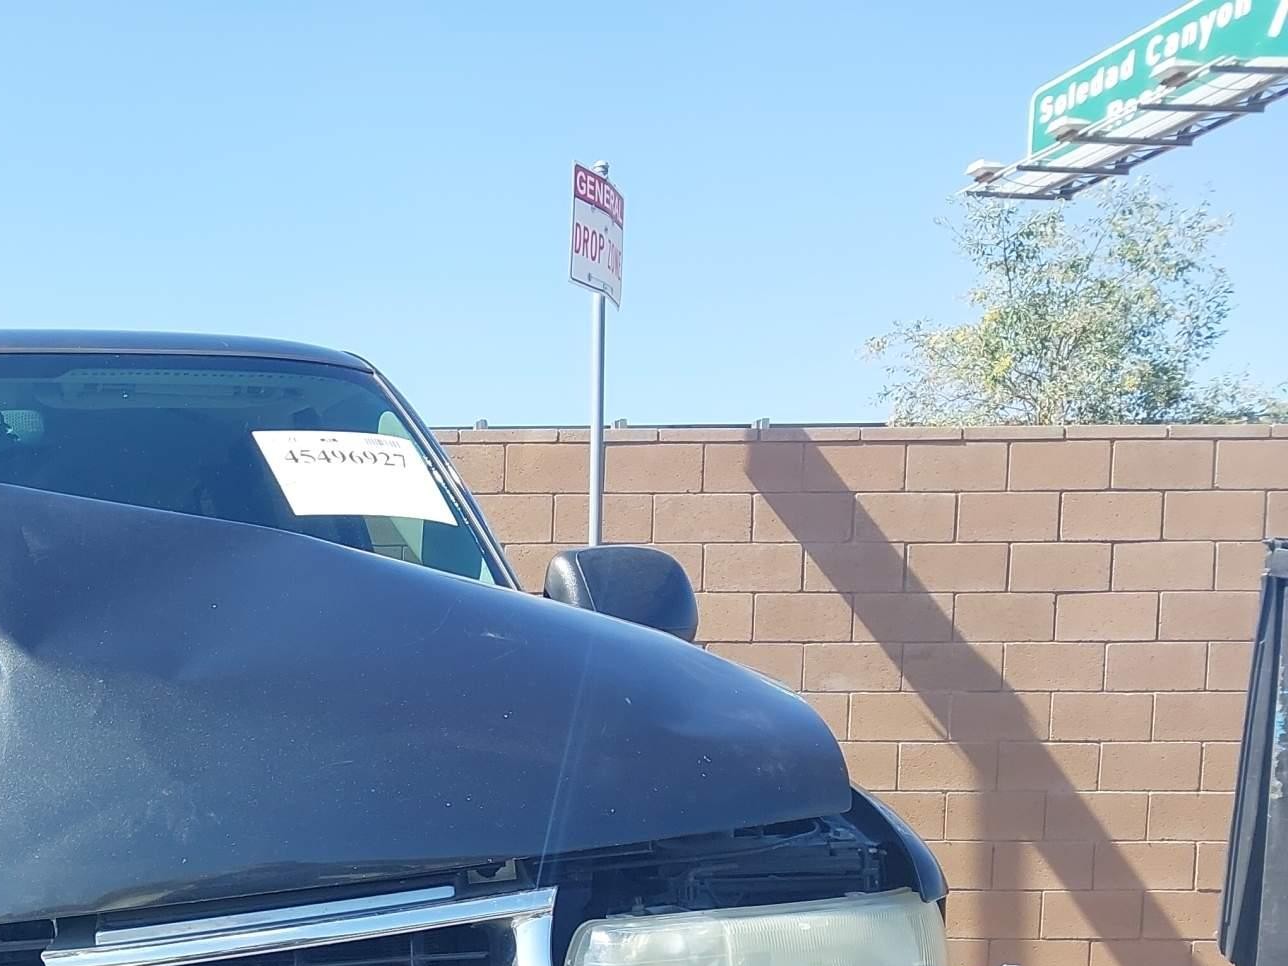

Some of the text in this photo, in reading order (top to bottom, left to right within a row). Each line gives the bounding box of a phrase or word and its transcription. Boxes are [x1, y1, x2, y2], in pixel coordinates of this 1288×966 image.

[1038, 49, 1136, 124] Soledad
[1144, 0, 1253, 67] Canyon
[576, 170, 623, 224] GENERAL
[573, 222, 605, 264] DROP
[284, 449, 407, 469] 45496927
